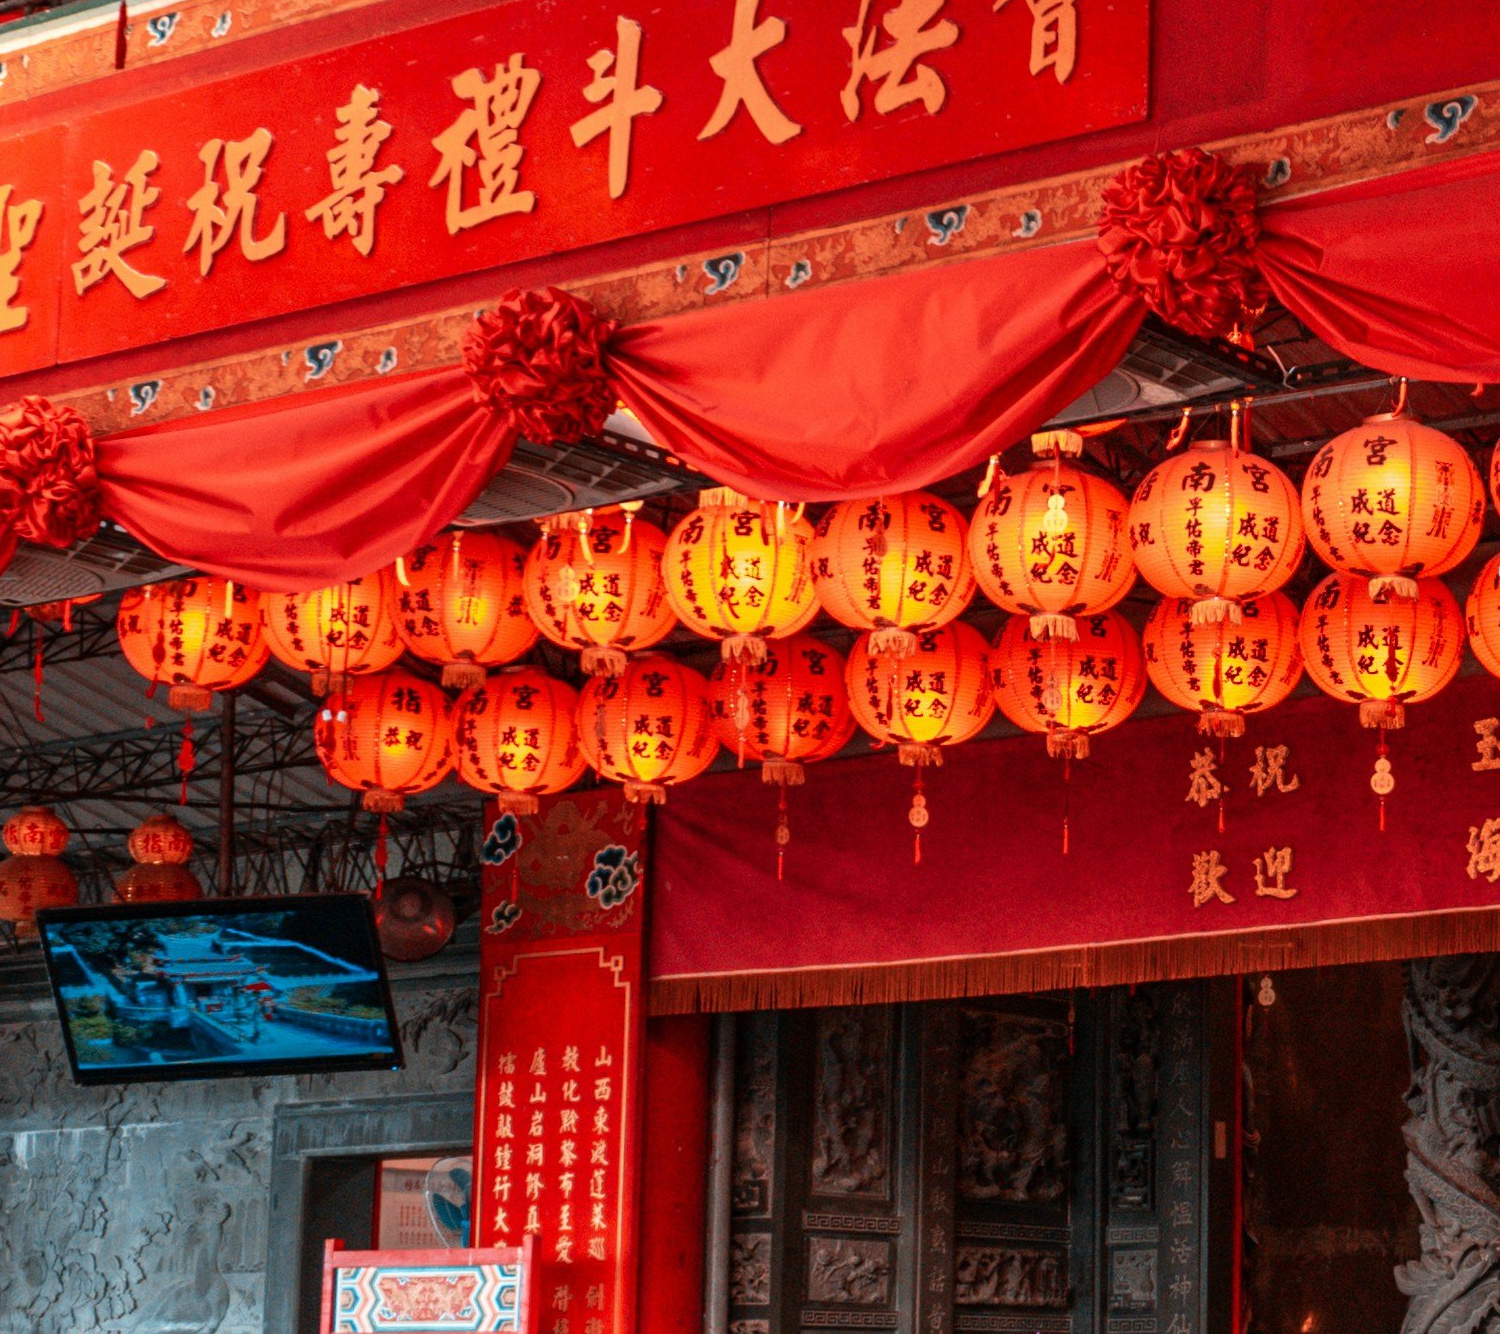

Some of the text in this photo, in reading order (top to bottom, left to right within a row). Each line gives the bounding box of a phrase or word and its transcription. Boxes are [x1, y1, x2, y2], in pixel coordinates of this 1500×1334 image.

[1350, 487, 1400, 516] 成道
[1184, 497, 1204, 576] 孚佑帝君
[1236, 513, 1281, 544] 成道
[1352, 519, 1401, 547] 紀念
[913, 551, 954, 580] 成道
[1230, 544, 1276, 570] 紀念
[905, 580, 949, 605] 紀念
[383, 726, 424, 750] 恭祝
[500, 726, 541, 751] 成道
[499, 745, 541, 772] 紀念
[1185, 745, 1299, 806] 恭祝
[1188, 847, 1298, 908] 歡迎
[493, 1051, 517, 1247] 擂鼓敲鐘行大
